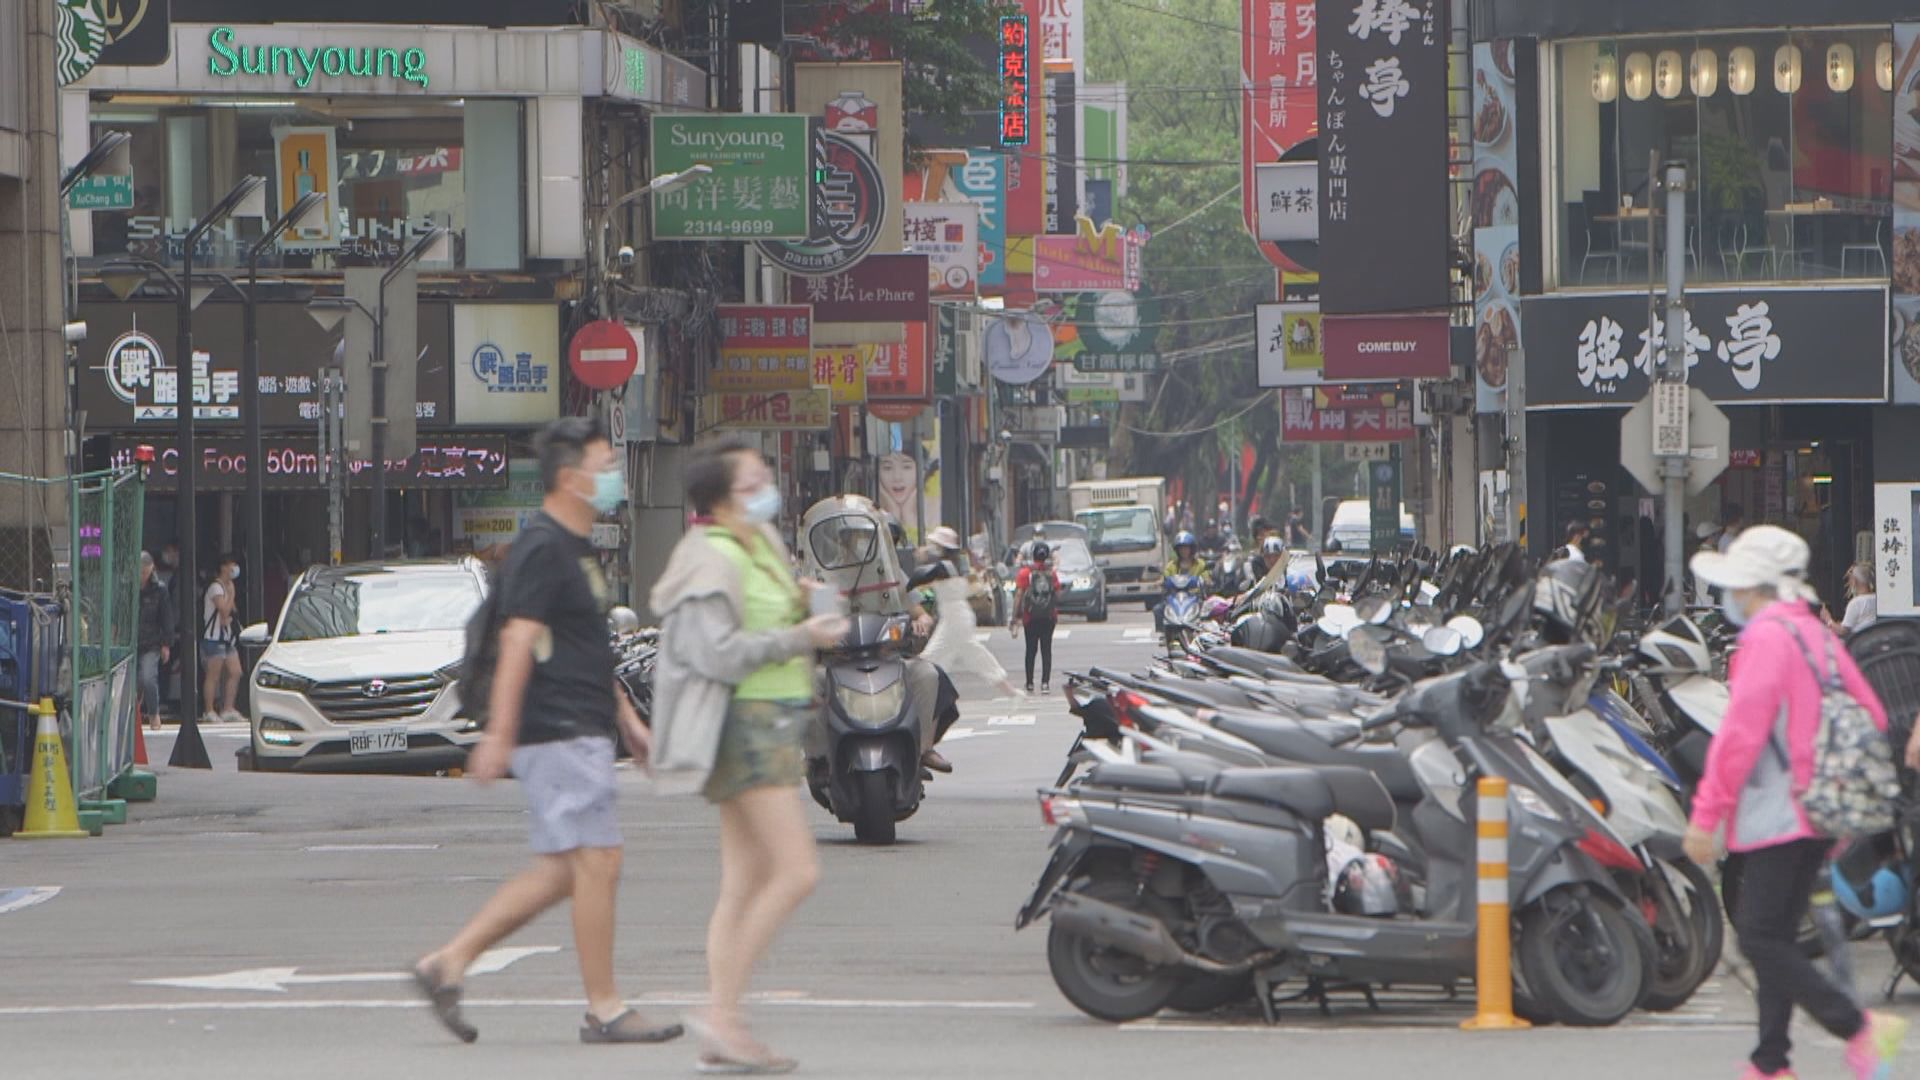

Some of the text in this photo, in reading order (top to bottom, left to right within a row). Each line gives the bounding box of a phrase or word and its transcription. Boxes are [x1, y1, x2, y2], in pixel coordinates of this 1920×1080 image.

[209, 27, 429, 88] Sunyoung
[671, 124, 785, 150] Sunyoung
[1270, 188, 1313, 213] 鮮茶
[684, 220, 774, 234] 2314-9699
[859, 287, 915, 301] Le Phare
[1577, 300, 1781, 390] 強棒亭
[479, 351, 549, 385] 戰略高手
[814, 353, 858, 385] 排骨
[141, 406, 233, 418] AZEC
